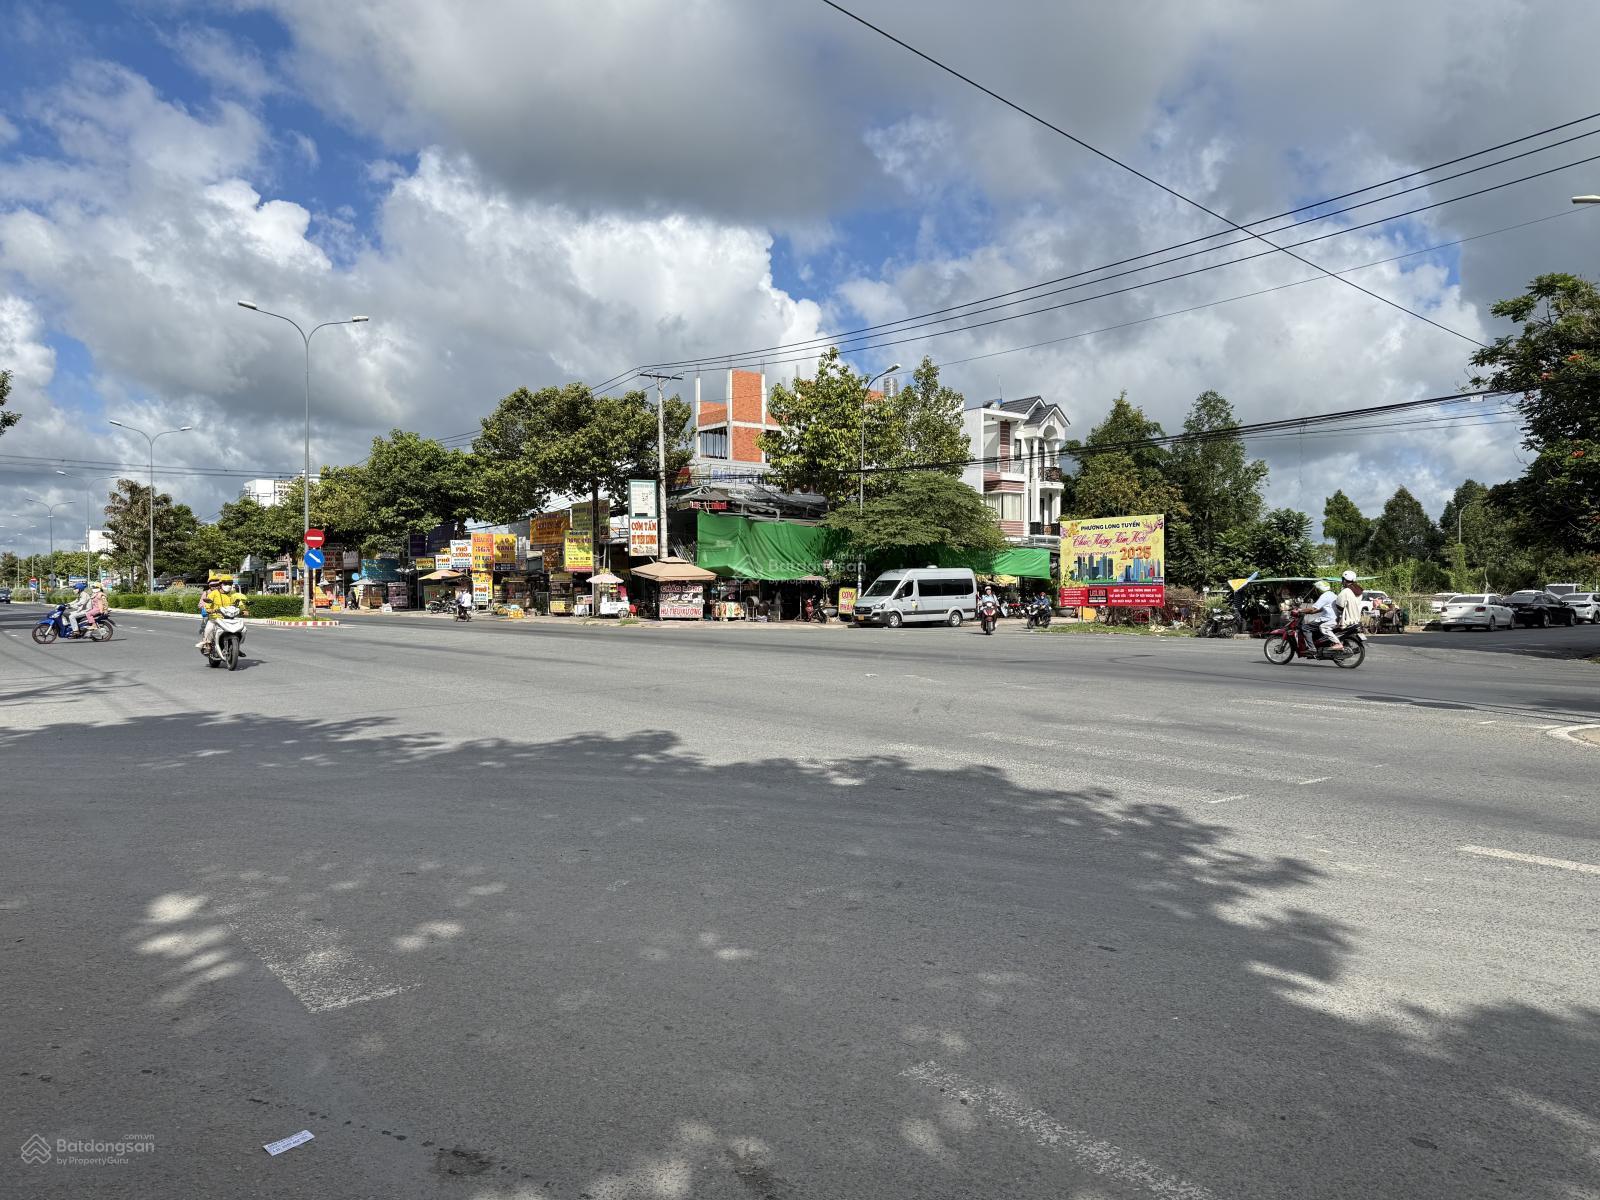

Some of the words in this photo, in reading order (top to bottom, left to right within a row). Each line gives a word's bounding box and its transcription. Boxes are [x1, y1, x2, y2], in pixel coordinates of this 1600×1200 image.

[631, 521, 643, 531] CƠM
[644, 520, 657, 531] TẤM
[1080, 523, 1104, 531] PHƯỜNG
[1104, 522, 1120, 530] LONG
[1119, 545, 1152, 560] 2025
